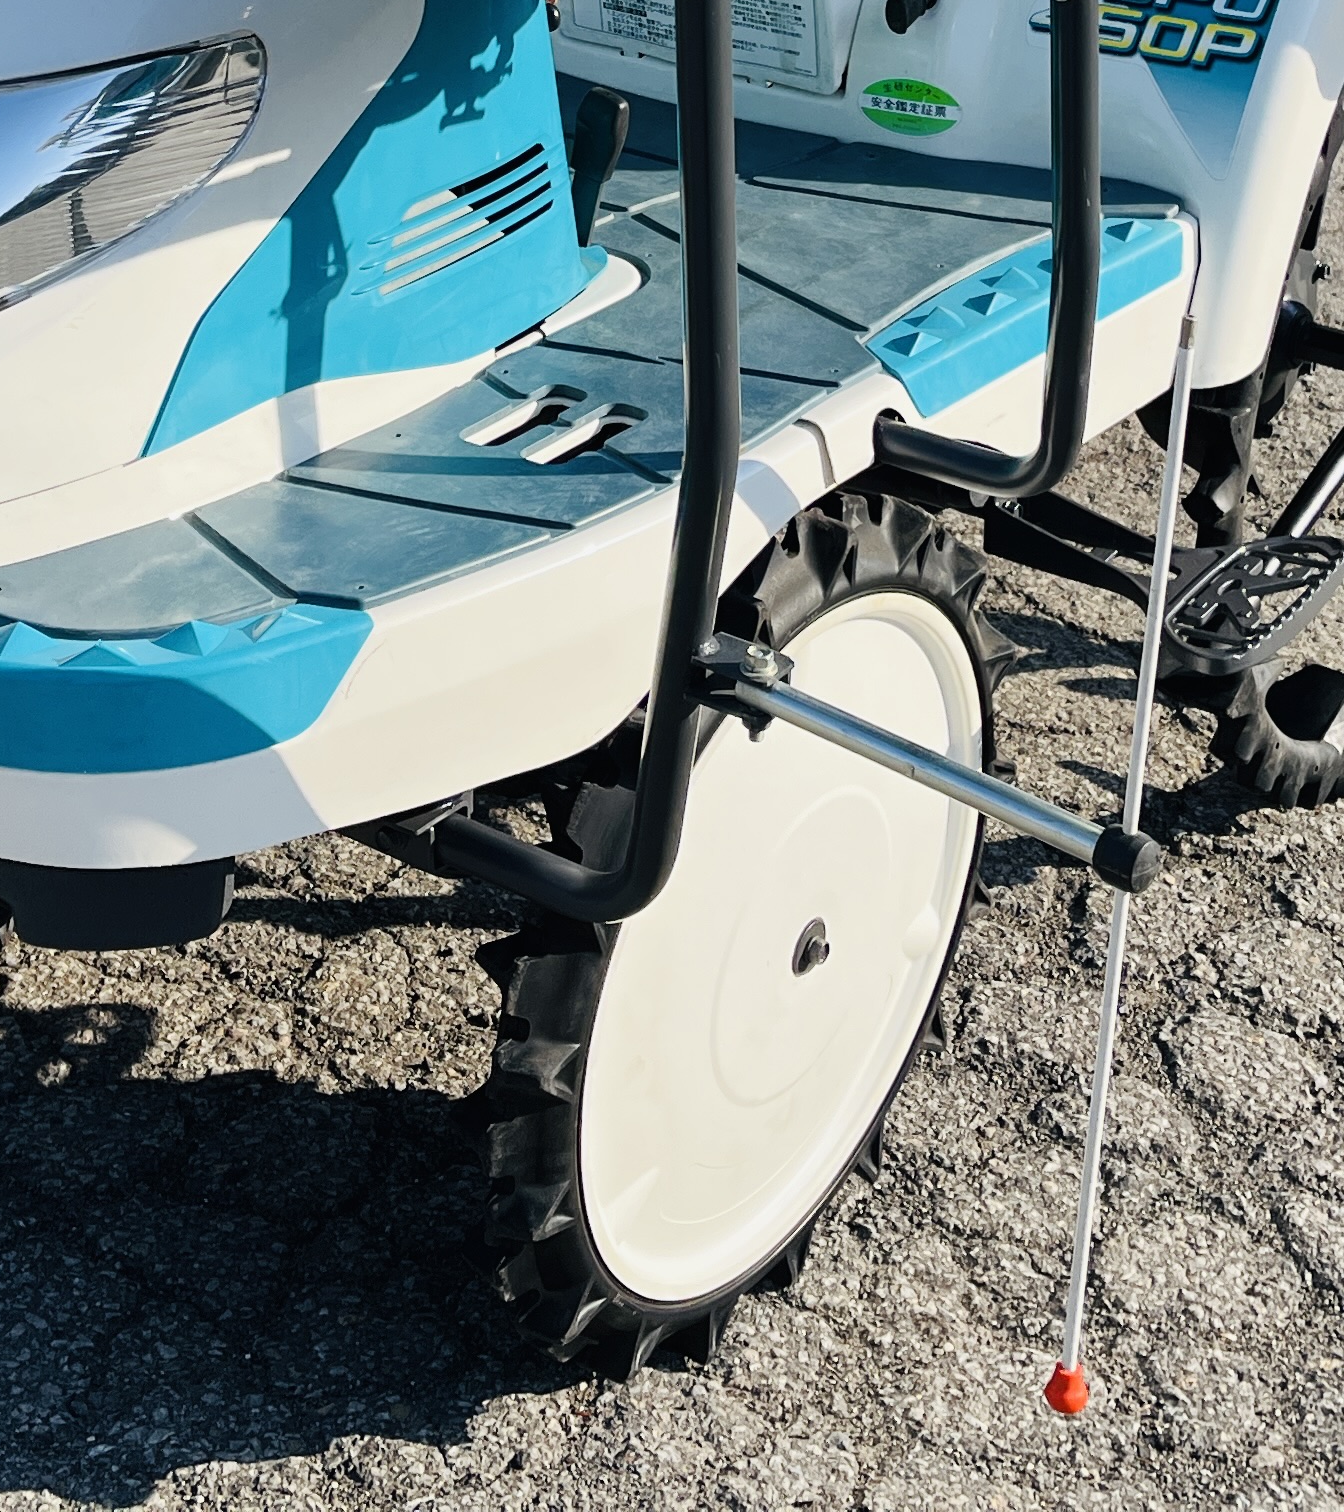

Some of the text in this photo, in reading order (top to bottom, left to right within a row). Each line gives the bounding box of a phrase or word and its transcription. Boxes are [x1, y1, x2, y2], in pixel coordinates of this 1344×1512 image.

[871, 96, 947, 118] 安全鑑定証票
